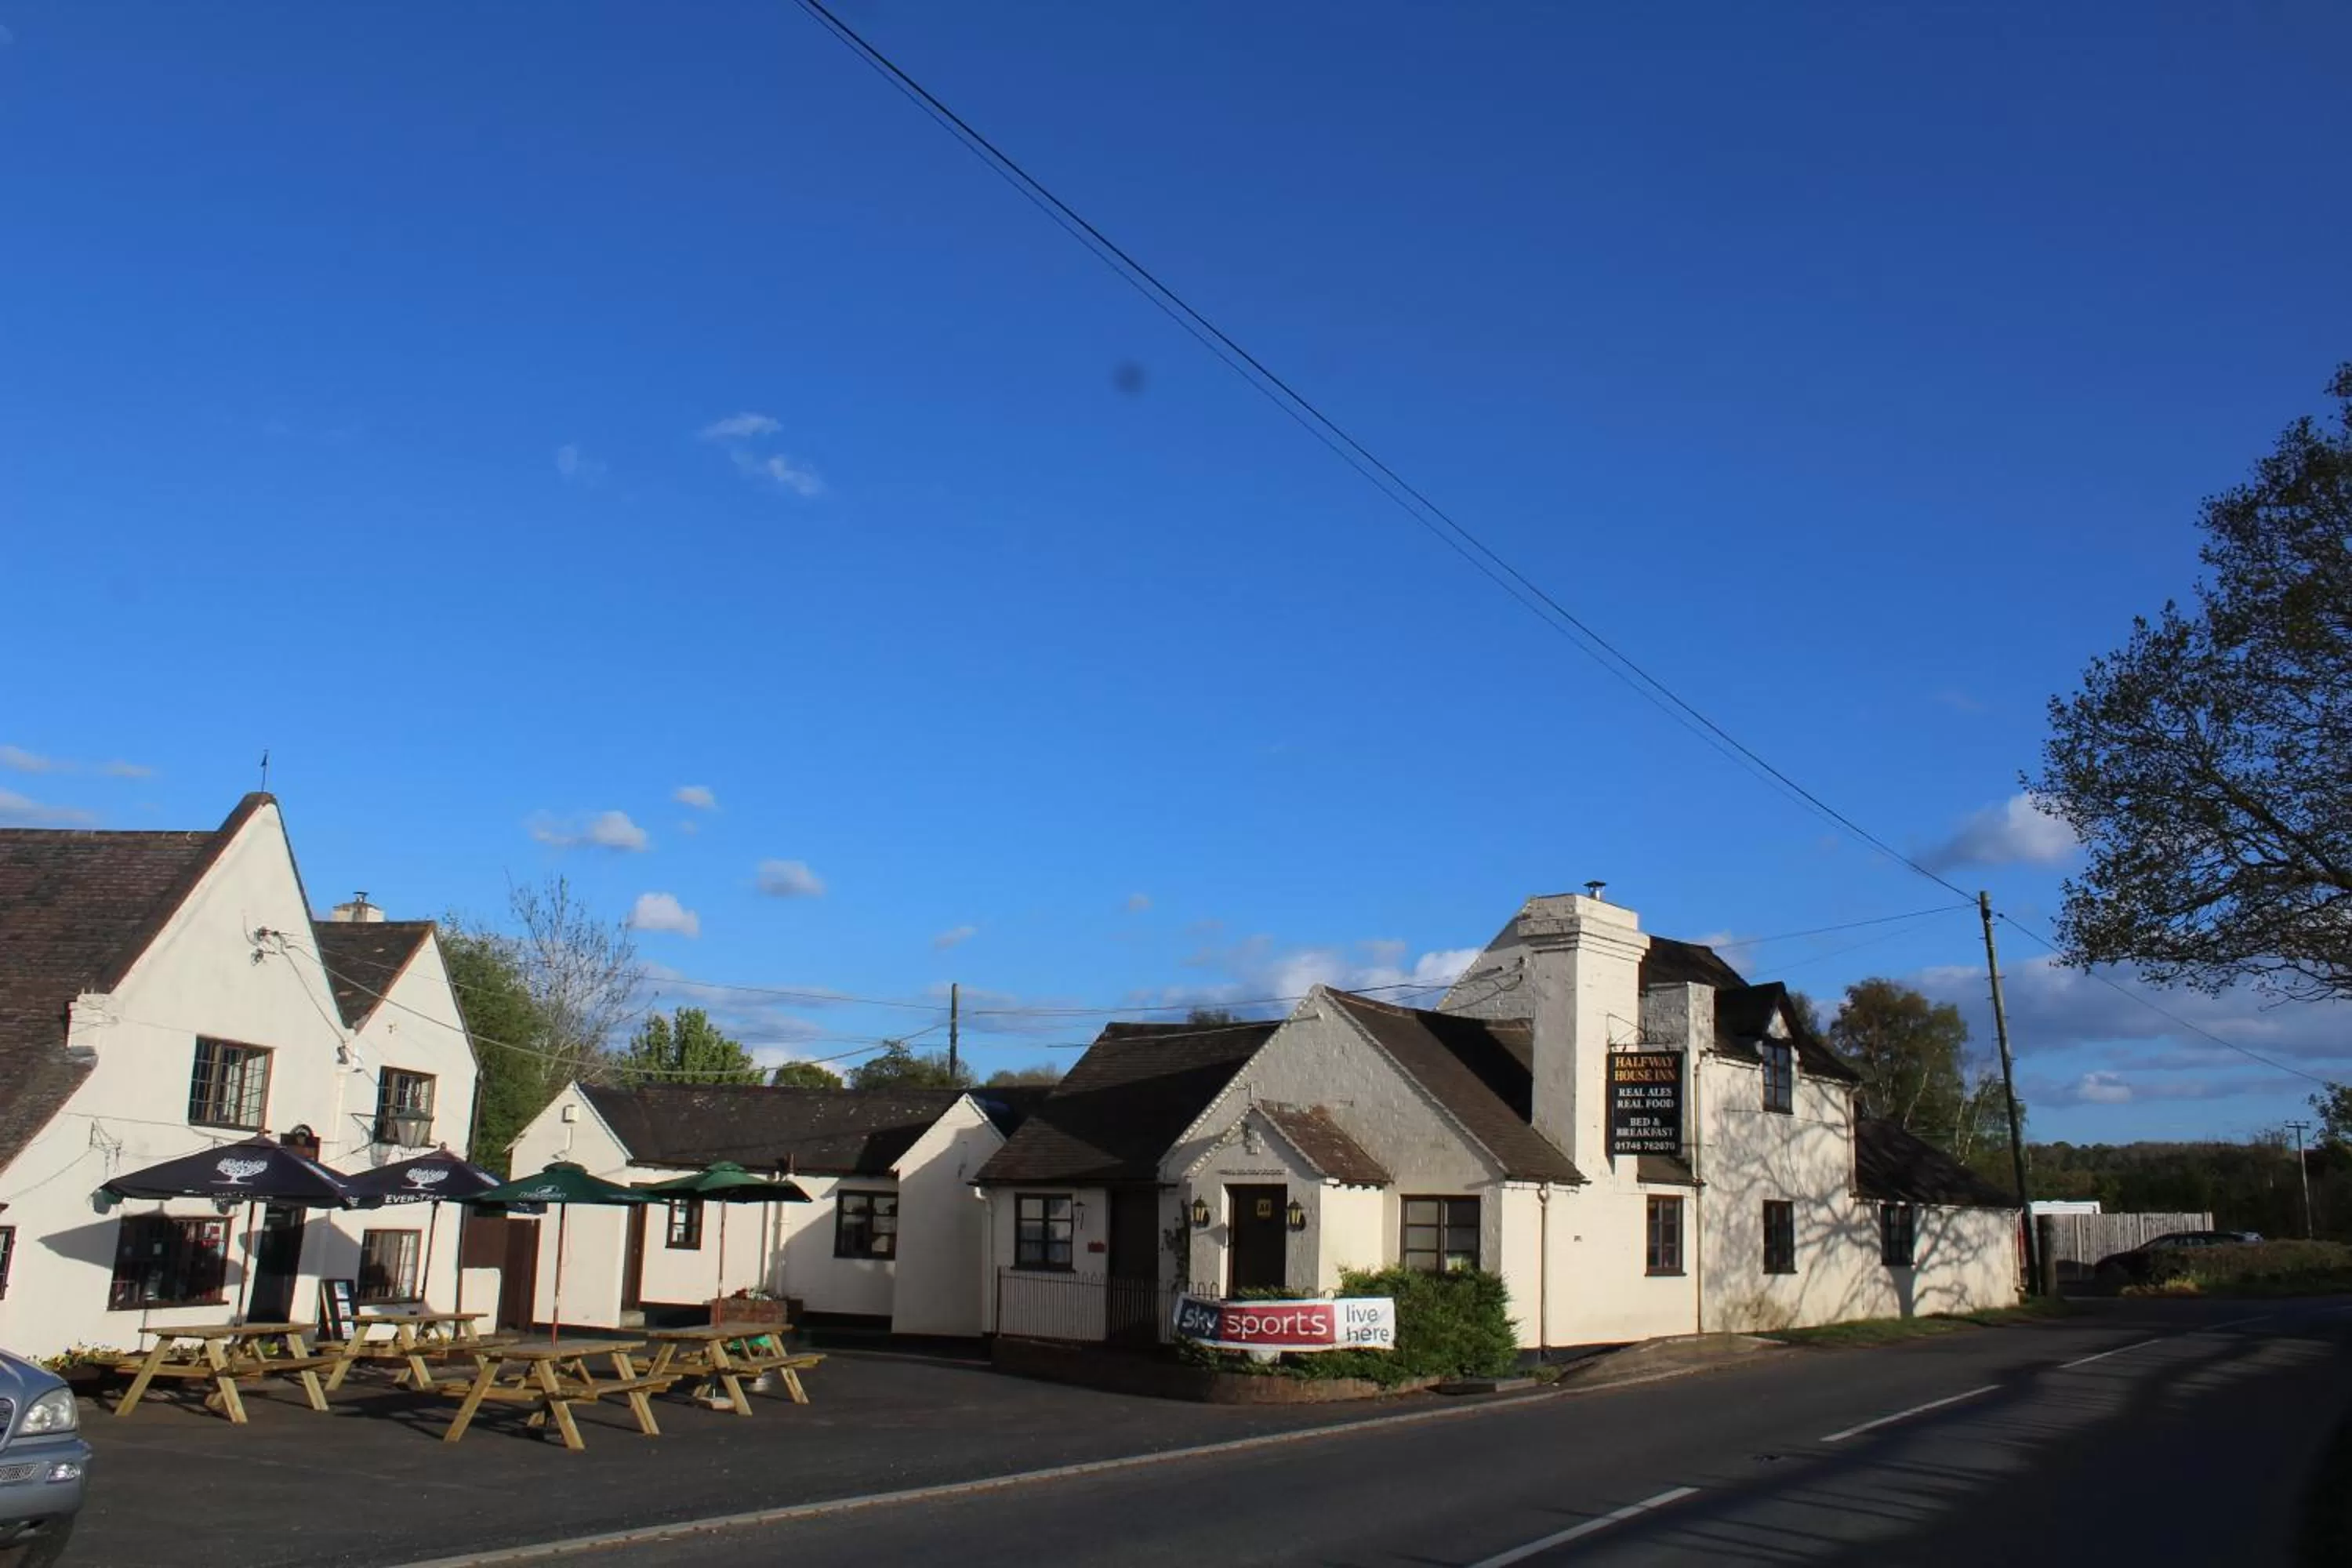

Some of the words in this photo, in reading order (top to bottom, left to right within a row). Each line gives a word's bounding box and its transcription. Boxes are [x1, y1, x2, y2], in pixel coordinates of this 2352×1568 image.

[1615, 1056, 1675, 1067] HALFWAY
[1614, 1069, 1653, 1081] HOUSE
[1654, 1069, 1675, 1081] INN
[1618, 1087, 1645, 1097] REAL
[1647, 1087, 1672, 1097] ALES
[1617, 1099, 1644, 1109] REAL
[1646, 1098, 1675, 1108] FOOD
[1630, 1117, 1650, 1127] BED
[1616, 1127, 1675, 1137] BREAKFAST
[1345, 1305, 1379, 1323] live
[1181, 1305, 1218, 1335] sky
[1226, 1311, 1328, 1340] sports
[1345, 1326, 1390, 1342] here
